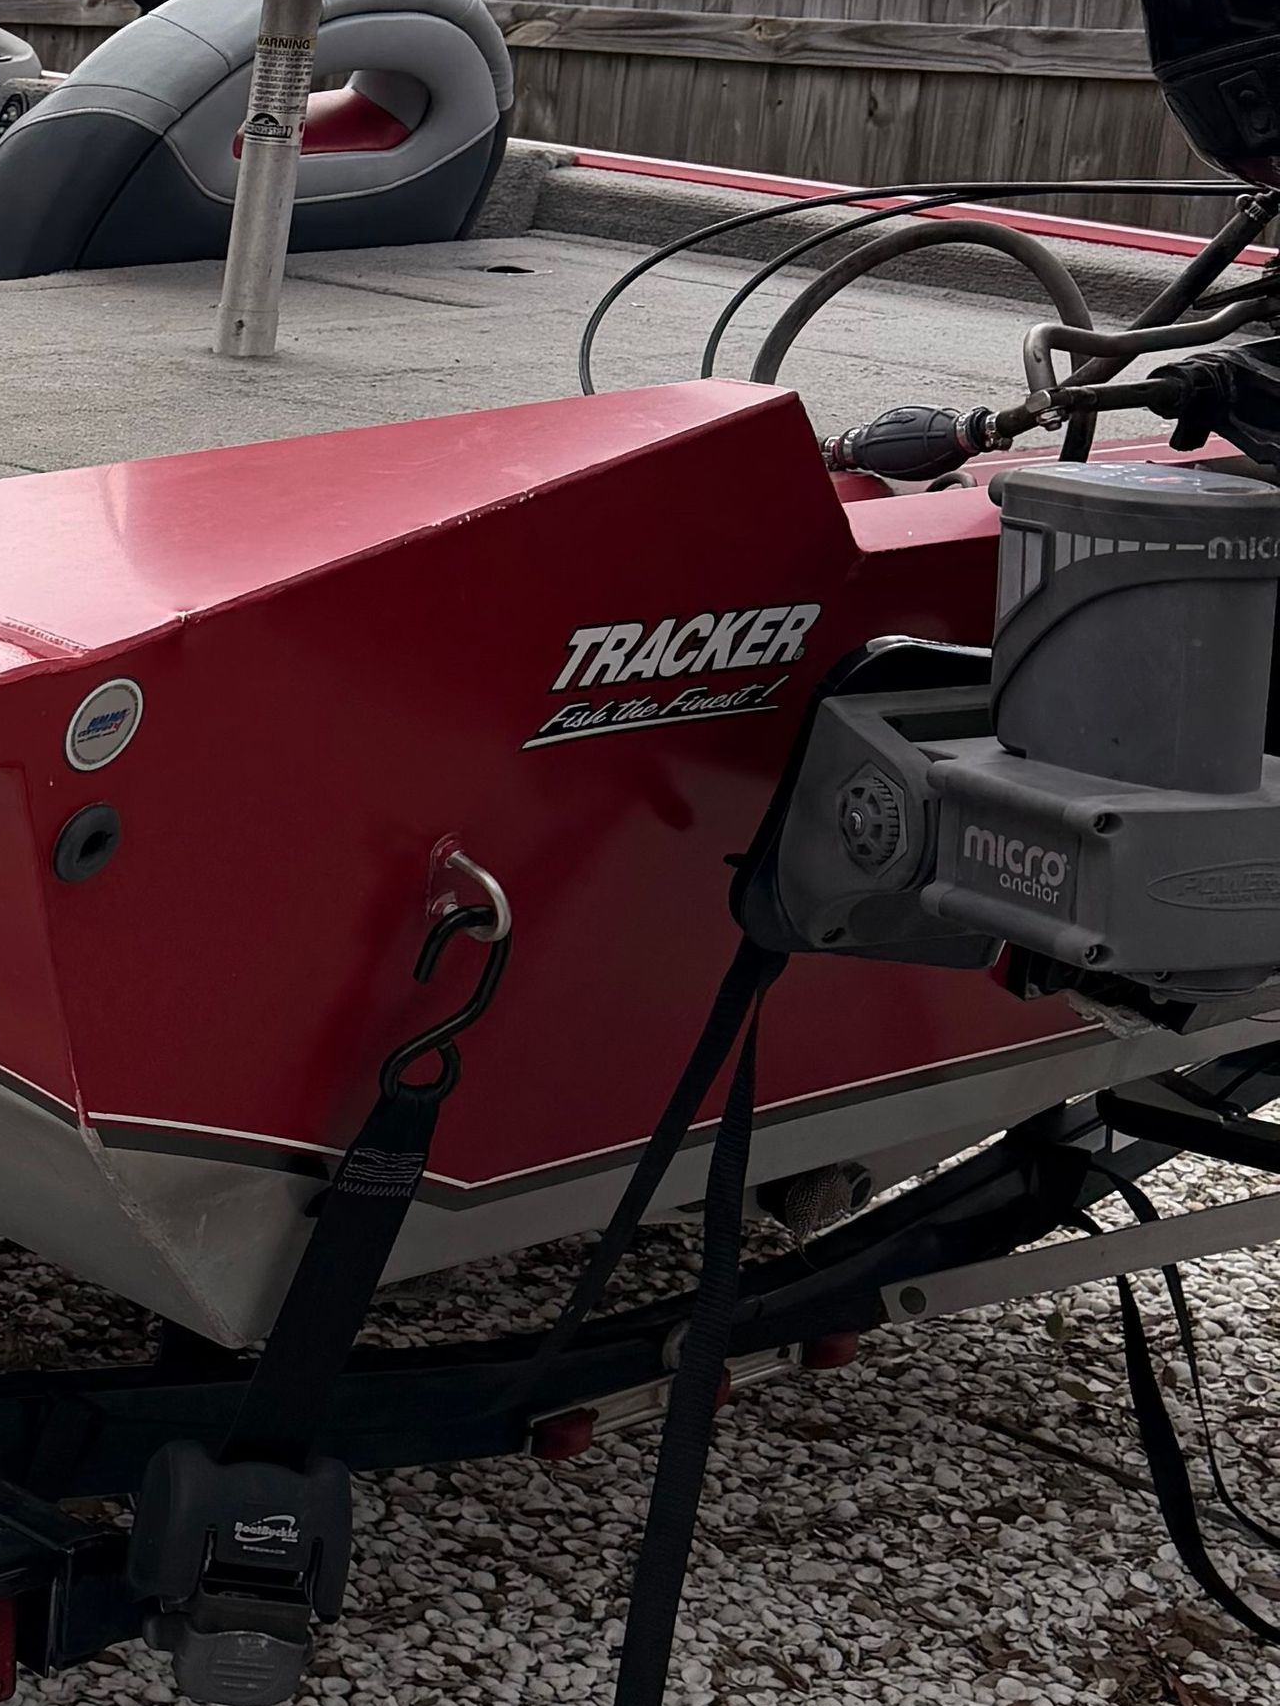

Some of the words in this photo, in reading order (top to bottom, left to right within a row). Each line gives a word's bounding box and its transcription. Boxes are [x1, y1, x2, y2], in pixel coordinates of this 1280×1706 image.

[551, 603, 821, 691] TRACKER
[539, 701, 614, 734] Fish
[610, 695, 659, 723] the
[963, 825, 1067, 887] micro
[999, 872, 1060, 905] anchor
